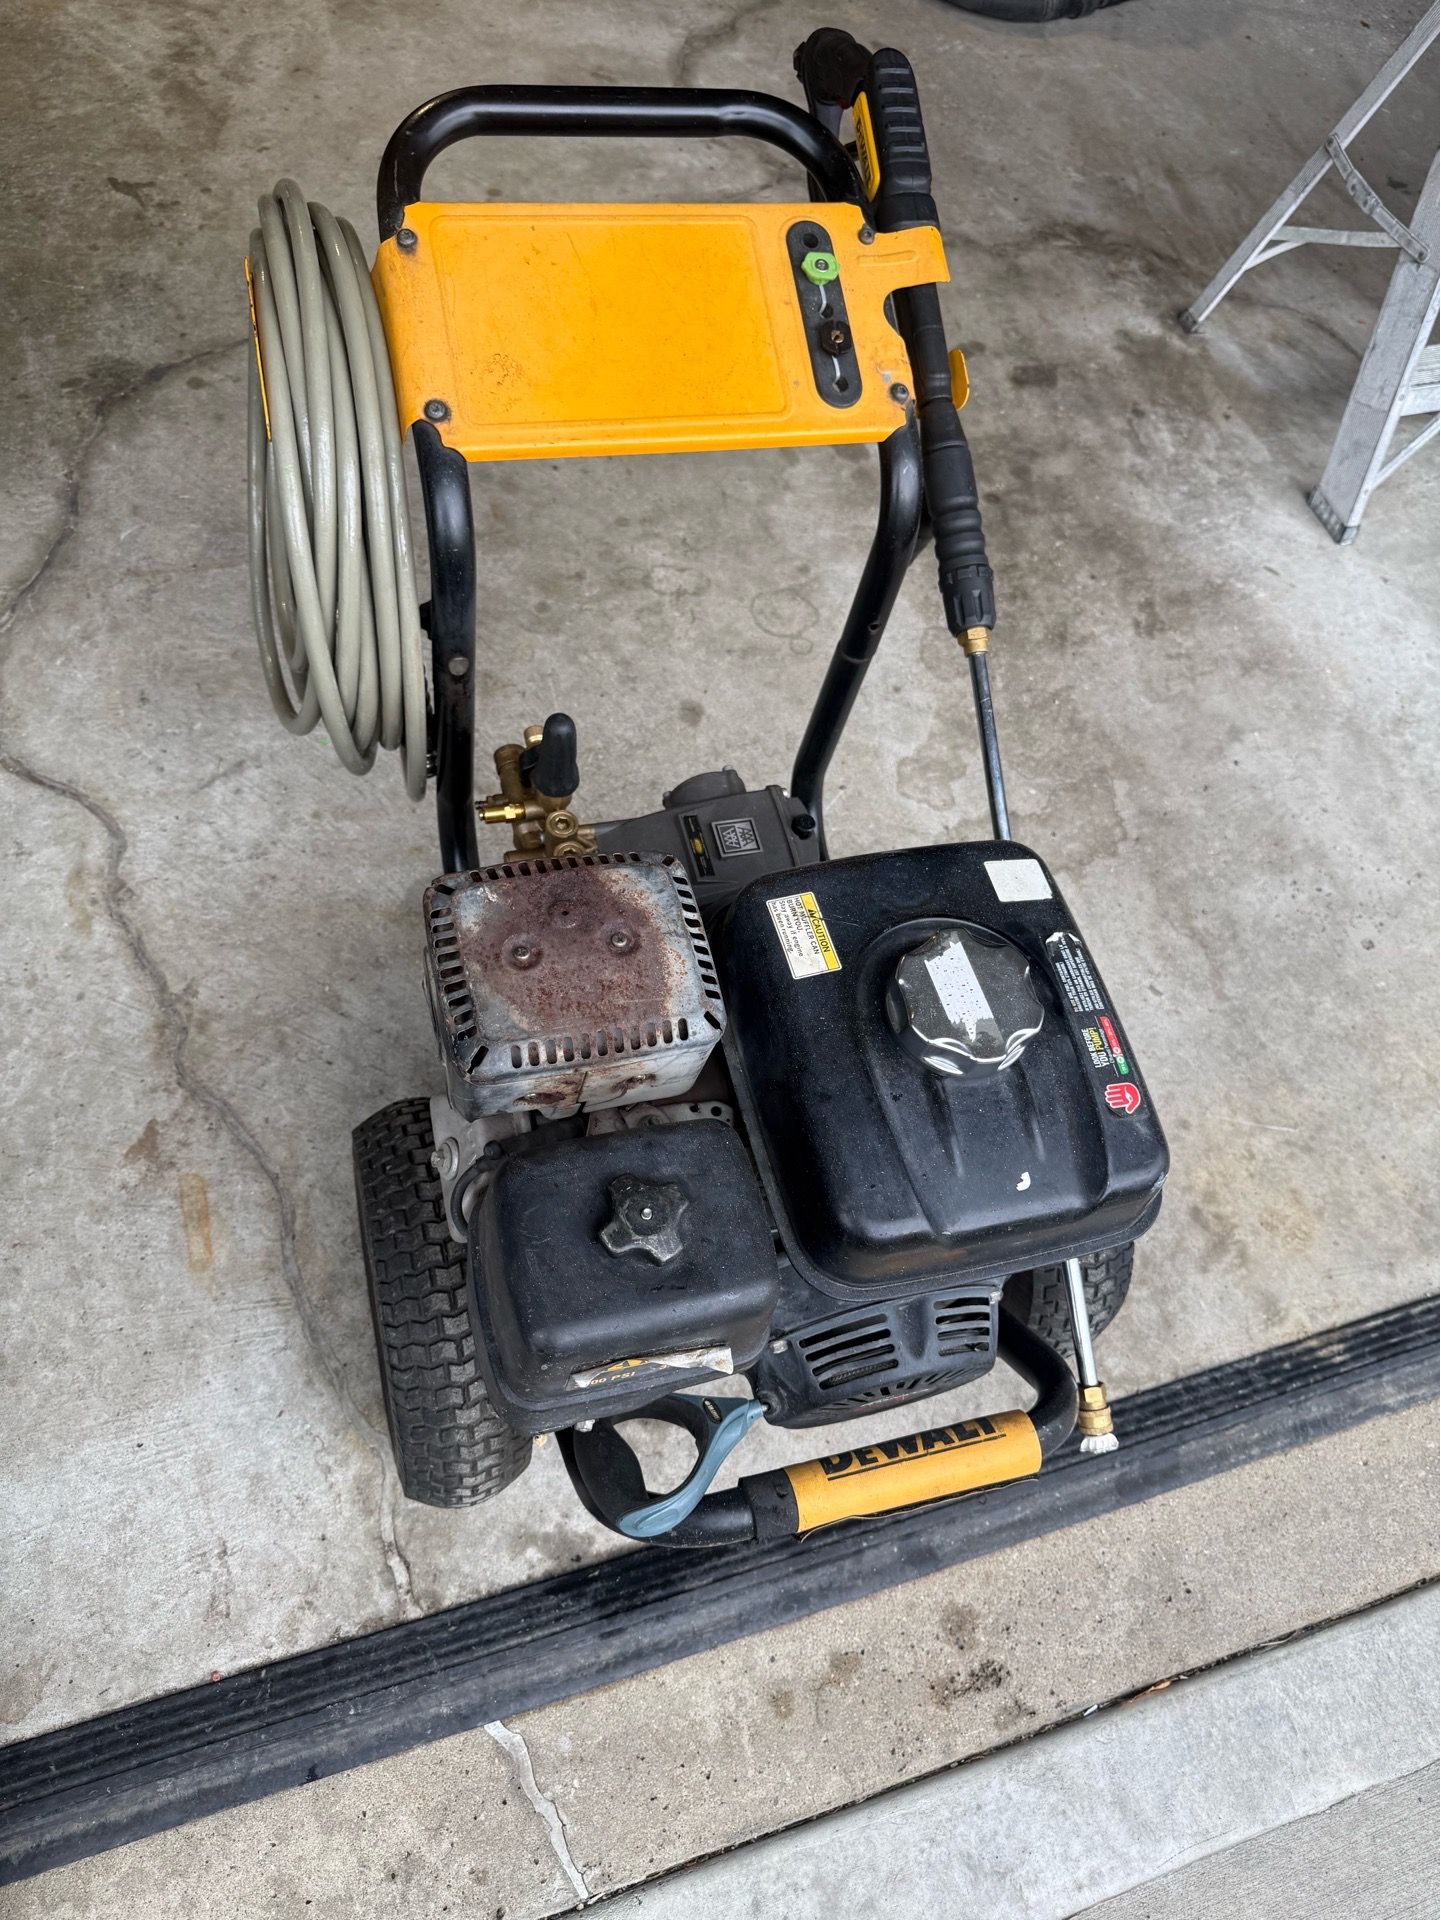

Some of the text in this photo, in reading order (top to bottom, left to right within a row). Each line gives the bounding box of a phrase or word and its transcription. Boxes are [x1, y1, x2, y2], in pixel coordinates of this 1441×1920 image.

[771, 901, 779, 912] has
[775, 913, 785, 929] been
[779, 900, 788, 913] Stay
[784, 914, 794, 929] away
[792, 936, 804, 957] engine
[786, 899, 804, 933] BURN YOU.
[794, 896, 820, 955] HOT MUFFLER CAN
[812, 918, 831, 953] CAUTION
[1081, 1028, 1097, 1052] BEFORE
[1088, 1027, 1104, 1050] PUMP!
[1090, 1052, 1102, 1068] LOOK
[1097, 1051, 1110, 1067] YOU
[611, 1371, 636, 1381] PSI
[818, 1417, 996, 1475] DEWALT
